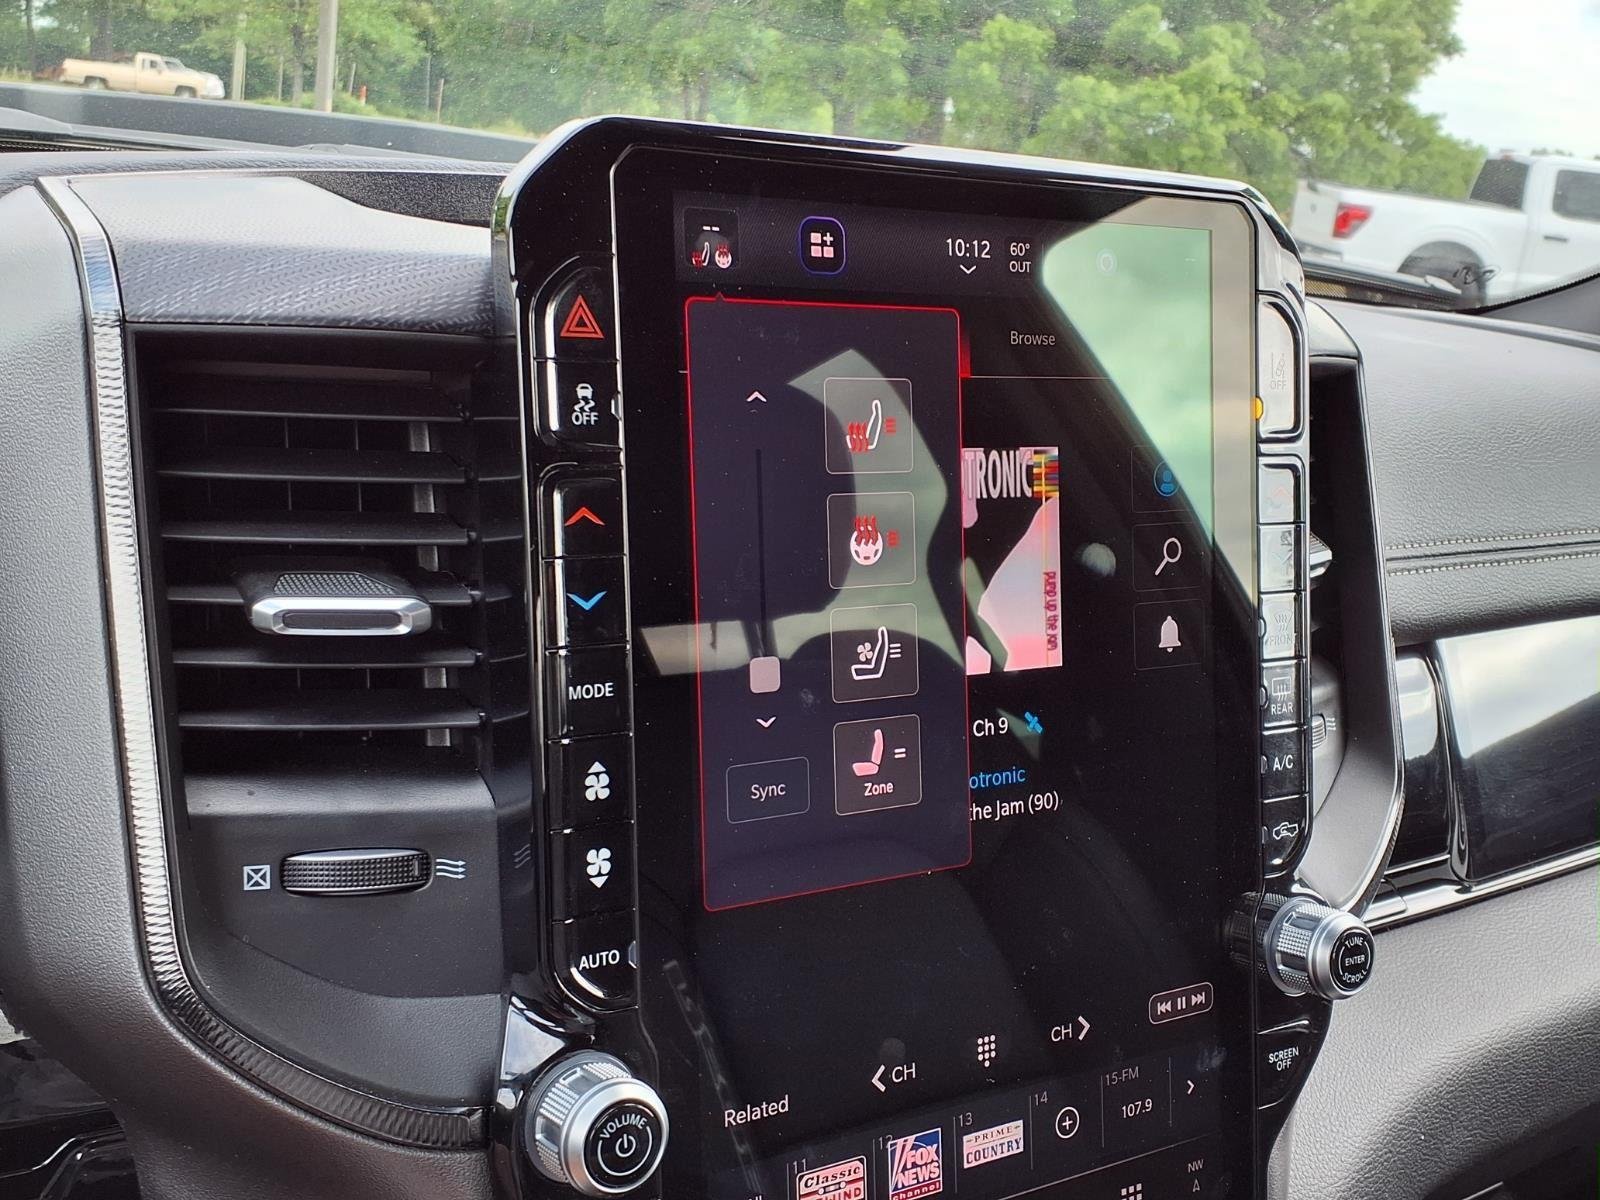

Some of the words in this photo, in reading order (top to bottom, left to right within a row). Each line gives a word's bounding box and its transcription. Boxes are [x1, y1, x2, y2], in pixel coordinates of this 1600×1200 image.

[946, 237, 991, 258] 10:12
[1009, 242, 1031, 257] 60°
[1009, 260, 1031, 274] OUT
[1009, 330, 1056, 346] Browse
[1270, 380, 1287, 390] OFF
[571, 411, 599, 425] OFF
[568, 683, 614, 700] MODE
[1271, 703, 1294, 715] REAR
[973, 718, 995, 737] Ch
[998, 717, 1009, 734] 9
[1273, 754, 1294, 770] A/C
[969, 766, 1026, 789] otronic
[750, 782, 786, 800] Sync
[864, 781, 894, 796] Zone
[970, 801, 993, 821] he
[995, 799, 1024, 821] Jam
[1028, 791, 1060, 814] (90)
[1345, 936, 1364, 949] TUNE
[578, 950, 620, 970] AUTO
[1345, 954, 1366, 967] ENTER
[1342, 969, 1368, 984] SCROLL
[1050, 1023, 1073, 1043] CH
[1268, 1047, 1299, 1063] SCREEN
[891, 1063, 917, 1083] CH
[1276, 1059, 1292, 1072] OFF
[1105, 1066, 1140, 1087] 15-FM
[1033, 1092, 1048, 1107] 14
[724, 1095, 789, 1127] Related
[1121, 1098, 1154, 1119] 107.9
[599, 1113, 648, 1139] VOLUME
[958, 1112, 973, 1127] 13
[974, 1125, 1013, 1143] PRIME
[906, 1143, 939, 1169] FOX
[966, 1137, 1022, 1165] COUNTRY
[792, 1158, 807, 1174] 11
[1187, 1159, 1204, 1173] NW
[804, 1166, 860, 1188] Classic
[897, 1162, 939, 1189] NEWS
